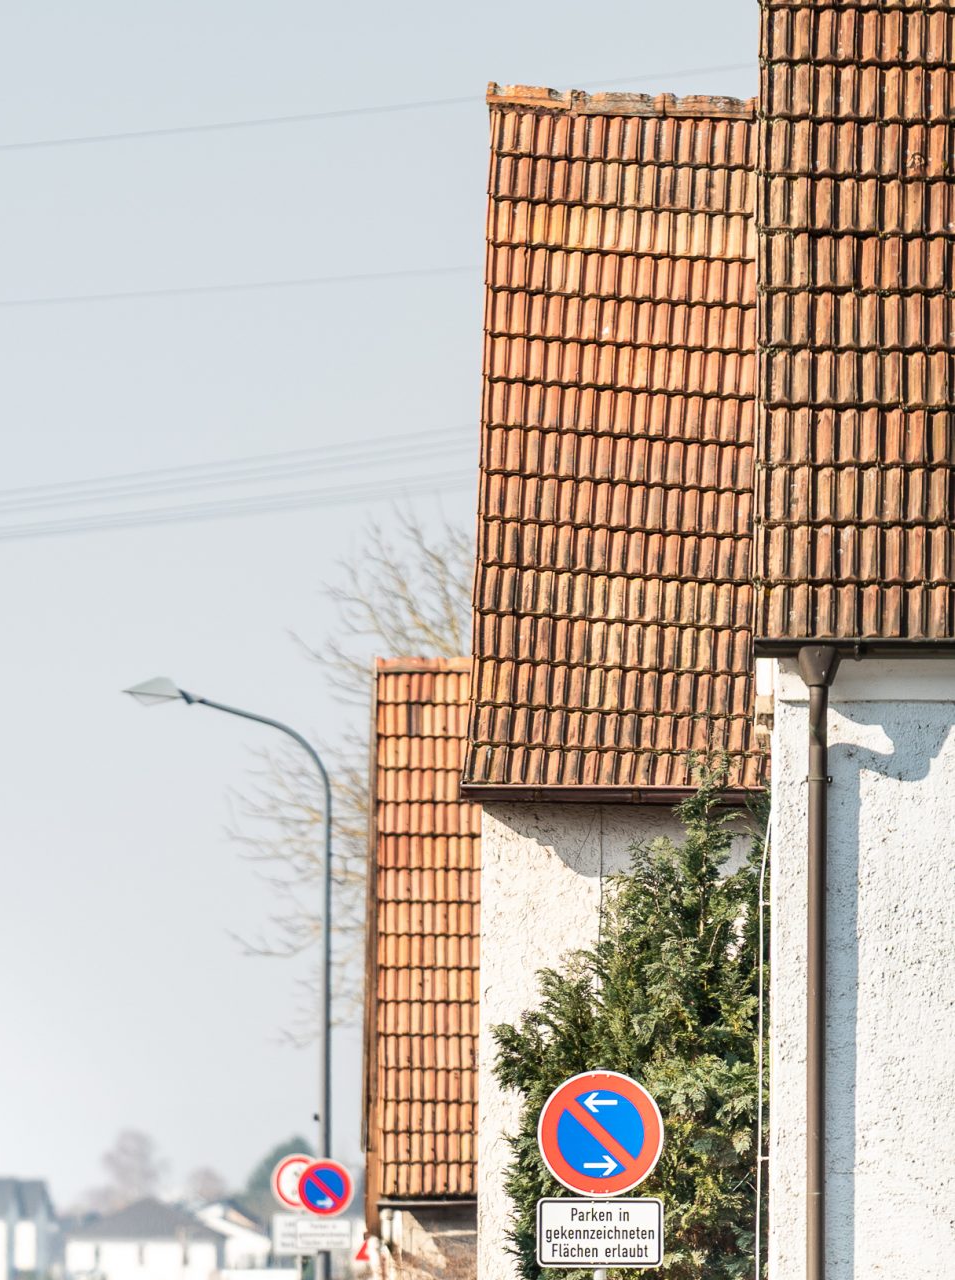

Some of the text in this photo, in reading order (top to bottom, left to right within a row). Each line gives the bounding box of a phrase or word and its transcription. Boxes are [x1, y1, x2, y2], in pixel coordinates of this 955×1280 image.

[571, 1207, 630, 1221] Parken in
[545, 1225, 655, 1242] gekennzeichneten
[551, 1243, 649, 1258] Flächen erlaubt
